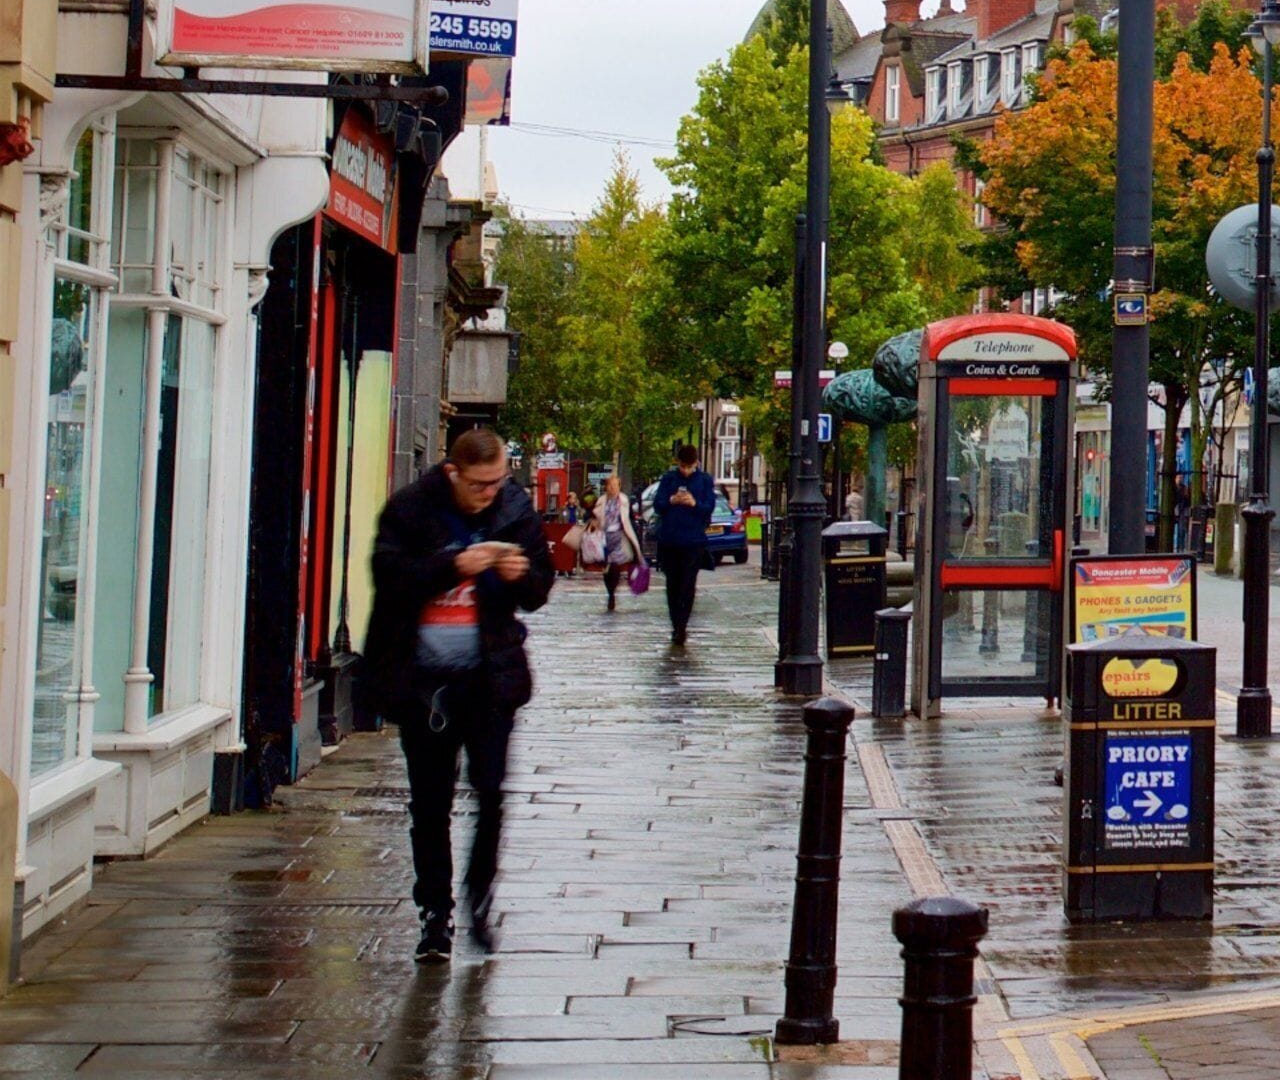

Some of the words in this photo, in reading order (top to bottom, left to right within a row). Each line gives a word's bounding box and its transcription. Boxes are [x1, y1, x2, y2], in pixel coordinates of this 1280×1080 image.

[468, 19, 513, 39] 5599
[974, 340, 1035, 355] Telephone
[966, 364, 996, 375] Coins
[997, 364, 1007, 375] &
[1009, 364, 1041, 375] Cards
[1091, 568, 1137, 577] Doncaster
[1140, 567, 1169, 575] Mobile
[1080, 597, 1121, 606] PHONES
[1124, 597, 1132, 605] &
[1135, 595, 1182, 605] GADGETS
[1105, 670, 1151, 685] epairs
[1113, 703, 1182, 720] LITTER
[1108, 745, 1189, 763] PRIORY
[1122, 771, 1175, 788] CAFE
